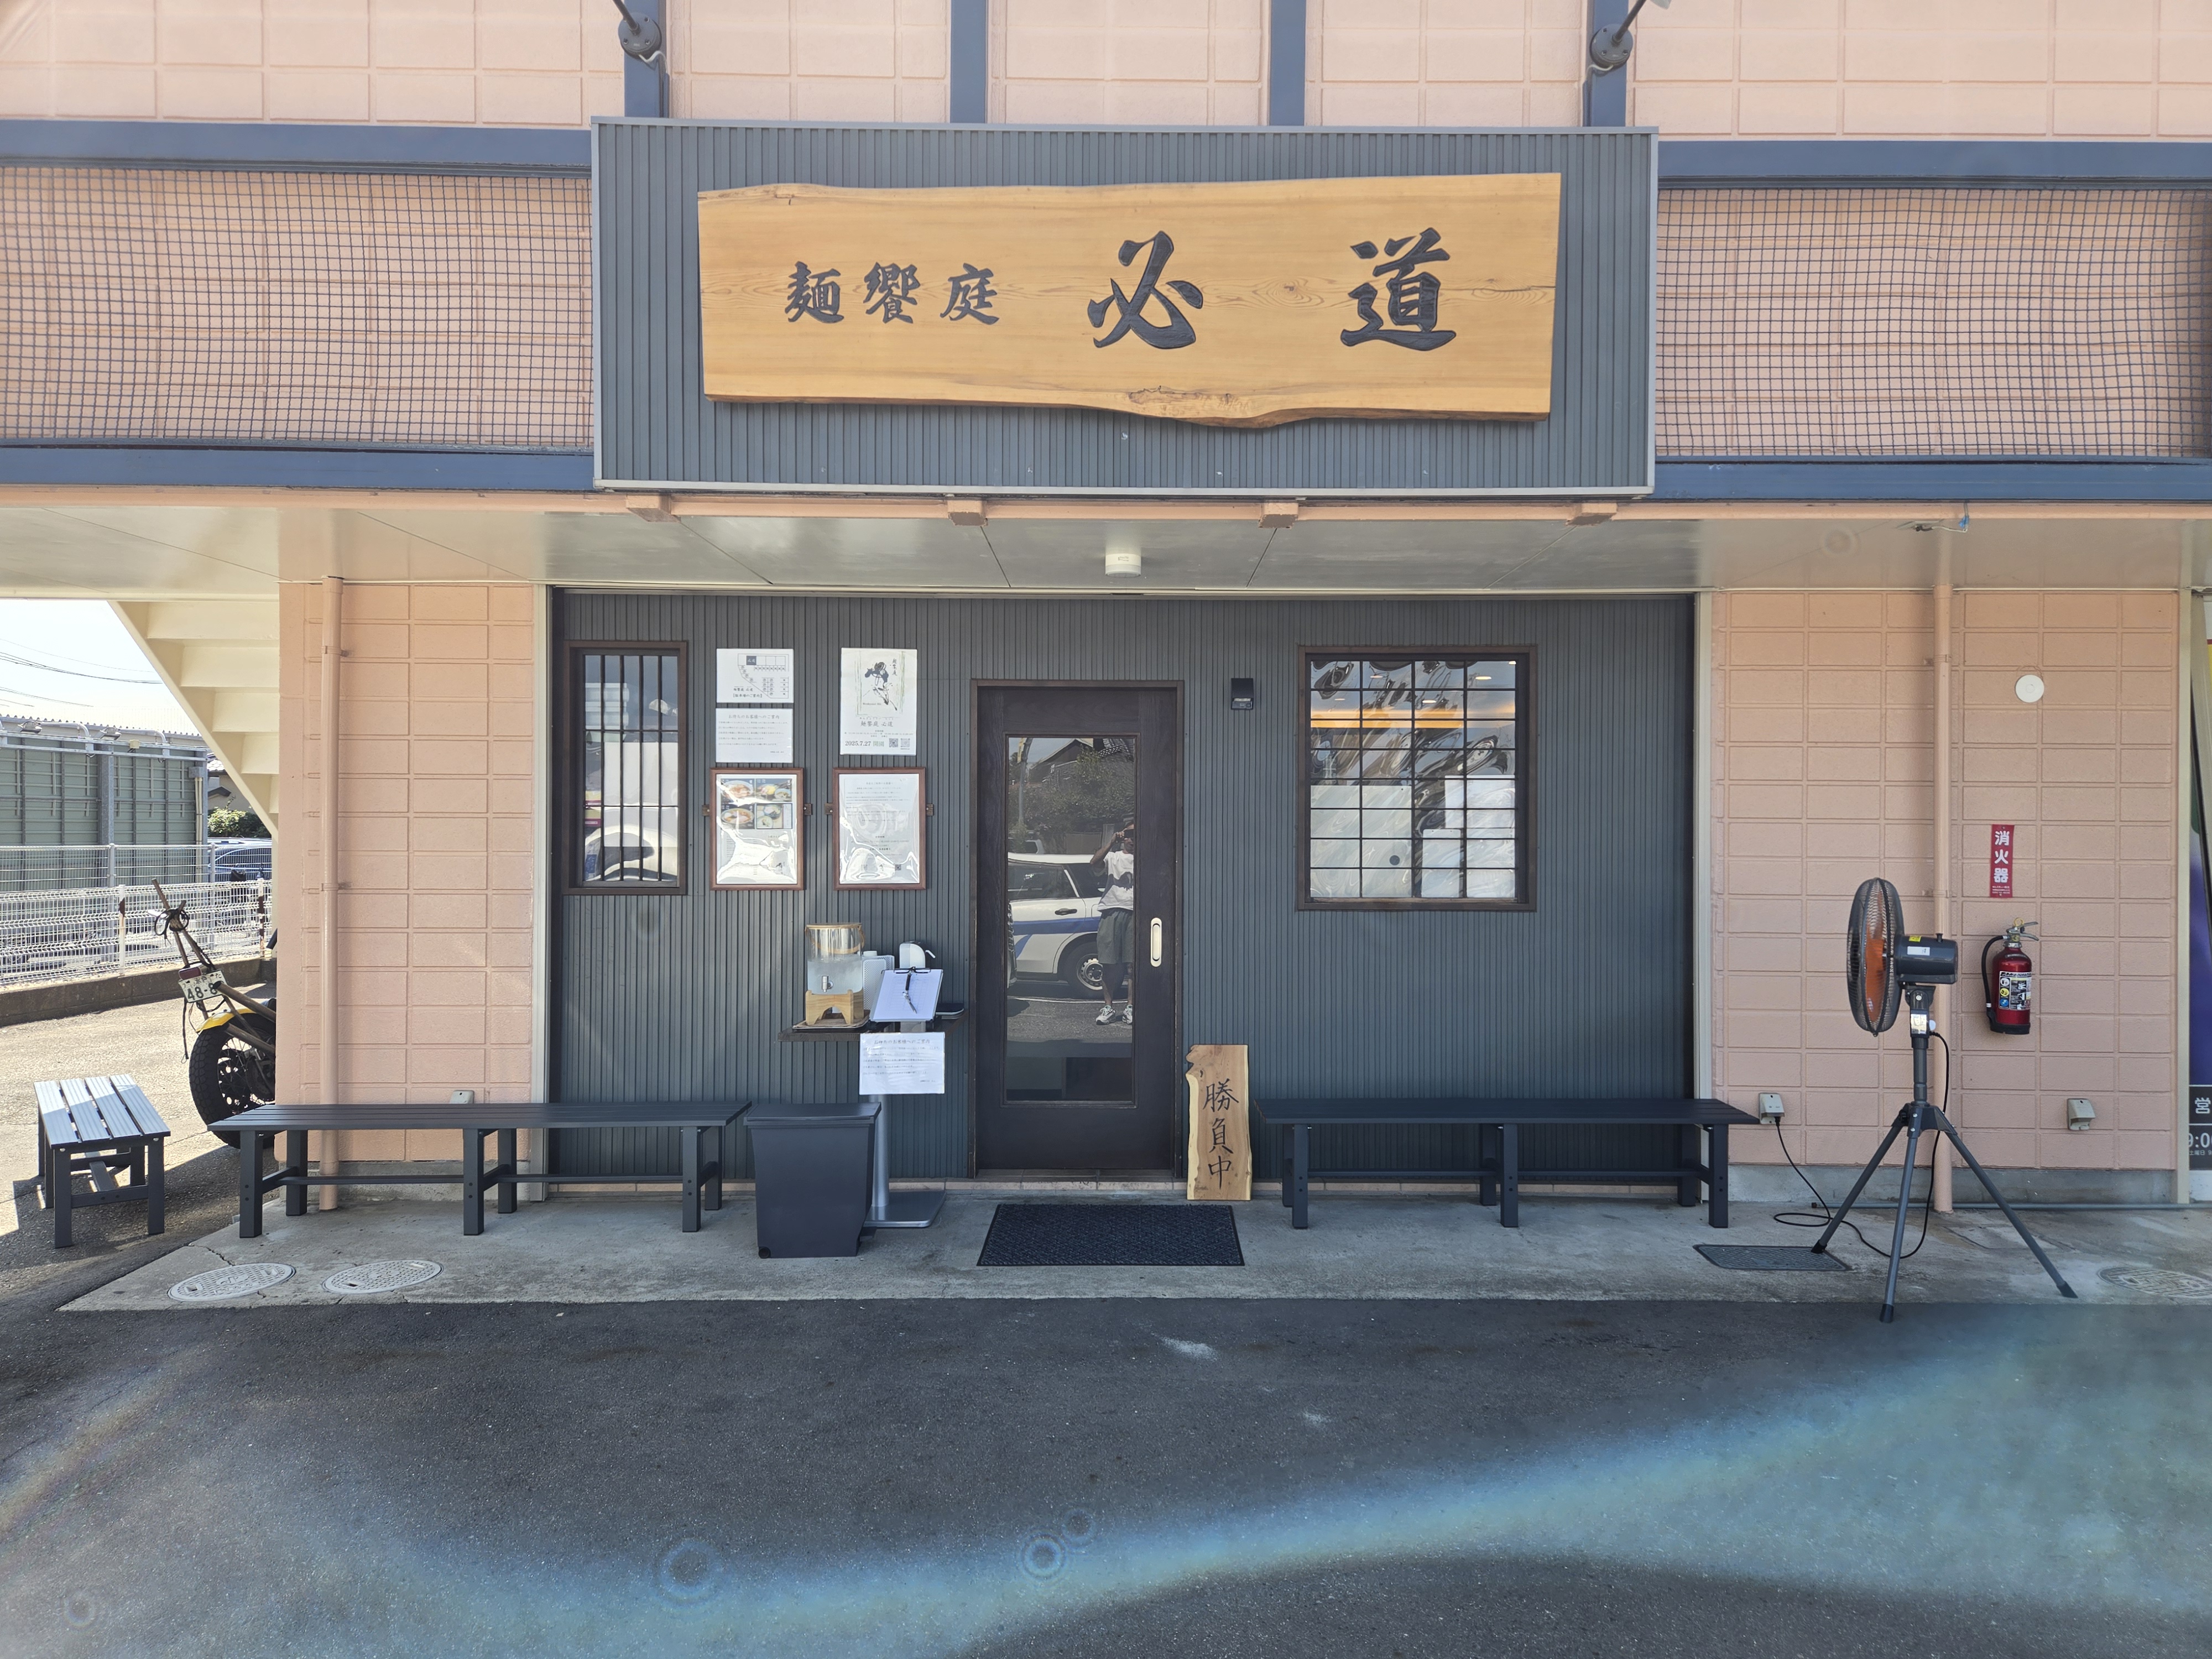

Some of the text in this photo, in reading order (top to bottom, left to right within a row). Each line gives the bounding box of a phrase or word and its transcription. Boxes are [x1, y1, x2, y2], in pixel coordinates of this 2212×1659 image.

[784, 262, 999, 325] 麺饗庭
[1994, 831, 2010, 883] 消火器
[187, 983, 218, 1000] 48-8
[1203, 1078, 1239, 1189] 勝負中
